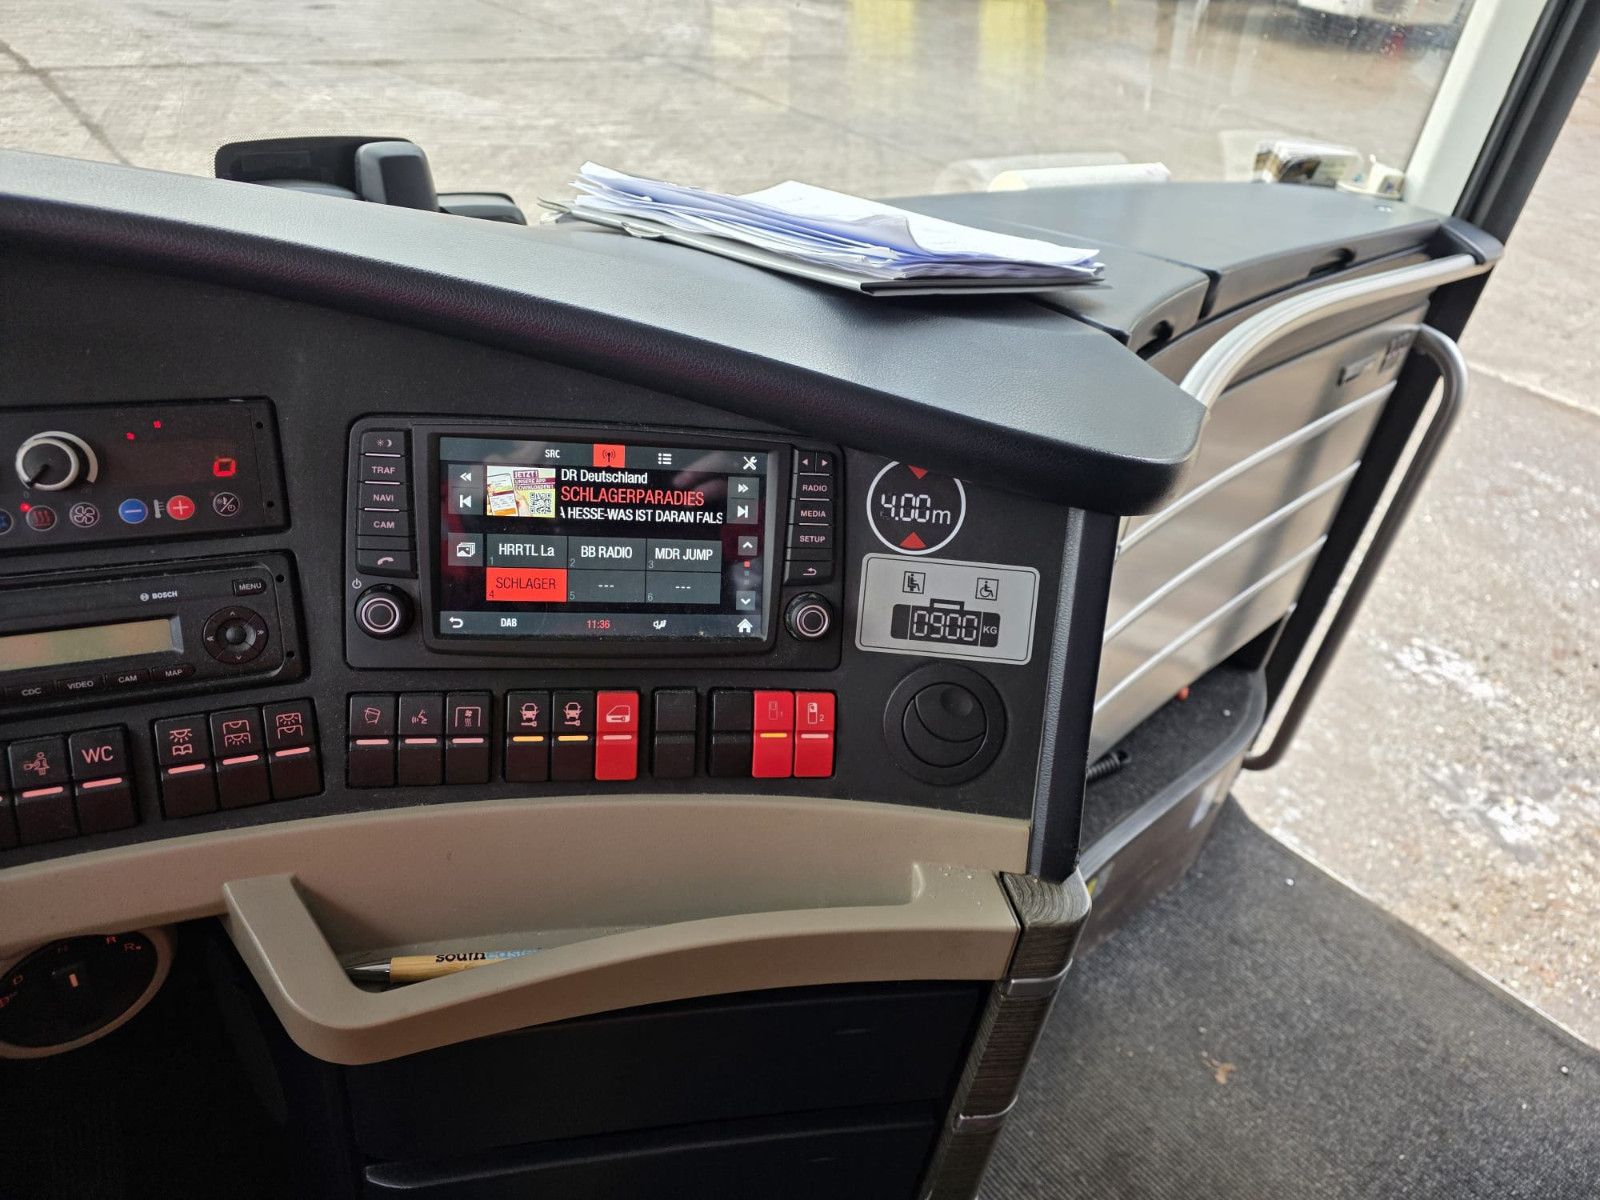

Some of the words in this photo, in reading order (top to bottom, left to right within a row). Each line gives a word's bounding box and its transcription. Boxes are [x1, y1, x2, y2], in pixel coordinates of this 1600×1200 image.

[544, 449, 561, 459] SRC
[371, 465, 396, 475] TRAF
[560, 468, 578, 482] DR
[580, 469, 648, 485] Deutschland
[802, 484, 828, 493] RADIO
[373, 493, 394, 502] NAVI
[560, 485, 705, 506] SCHLAGERPARADIES
[567, 506, 634, 522] HESSE-WAS
[635, 508, 653, 522] IST
[655, 509, 696, 524] DARAN
[800, 509, 826, 518] MEDIA
[373, 520, 396, 529] CAM
[799, 535, 826, 544] SETUP
[498, 543, 538, 557] HRRTL
[540, 544, 555, 557] La
[580, 545, 597, 558] BB
[598, 546, 633, 559] RADIO
[654, 547, 681, 560] MDR
[682, 548, 714, 562] JUMP
[569, 558, 576, 568] 2
[648, 560, 654, 569] 3
[238, 581, 262, 591] MENU
[495, 577, 556, 590] SCHLAGER
[152, 590, 178, 599] BOSCH
[489, 590, 495, 599] 4
[569, 591, 576, 600] 5
[647, 592, 654, 602] 6
[500, 618, 518, 628] DAB
[586, 619, 610, 630] 11:36
[982, 625, 998, 635] KG
[165, 668, 183, 678] MAP
[118, 674, 138, 683] CAM
[67, 679, 94, 690] VIDEO
[21, 687, 42, 697] CDC
[819, 714, 825, 722] 2
[82, 745, 114, 765] WC
